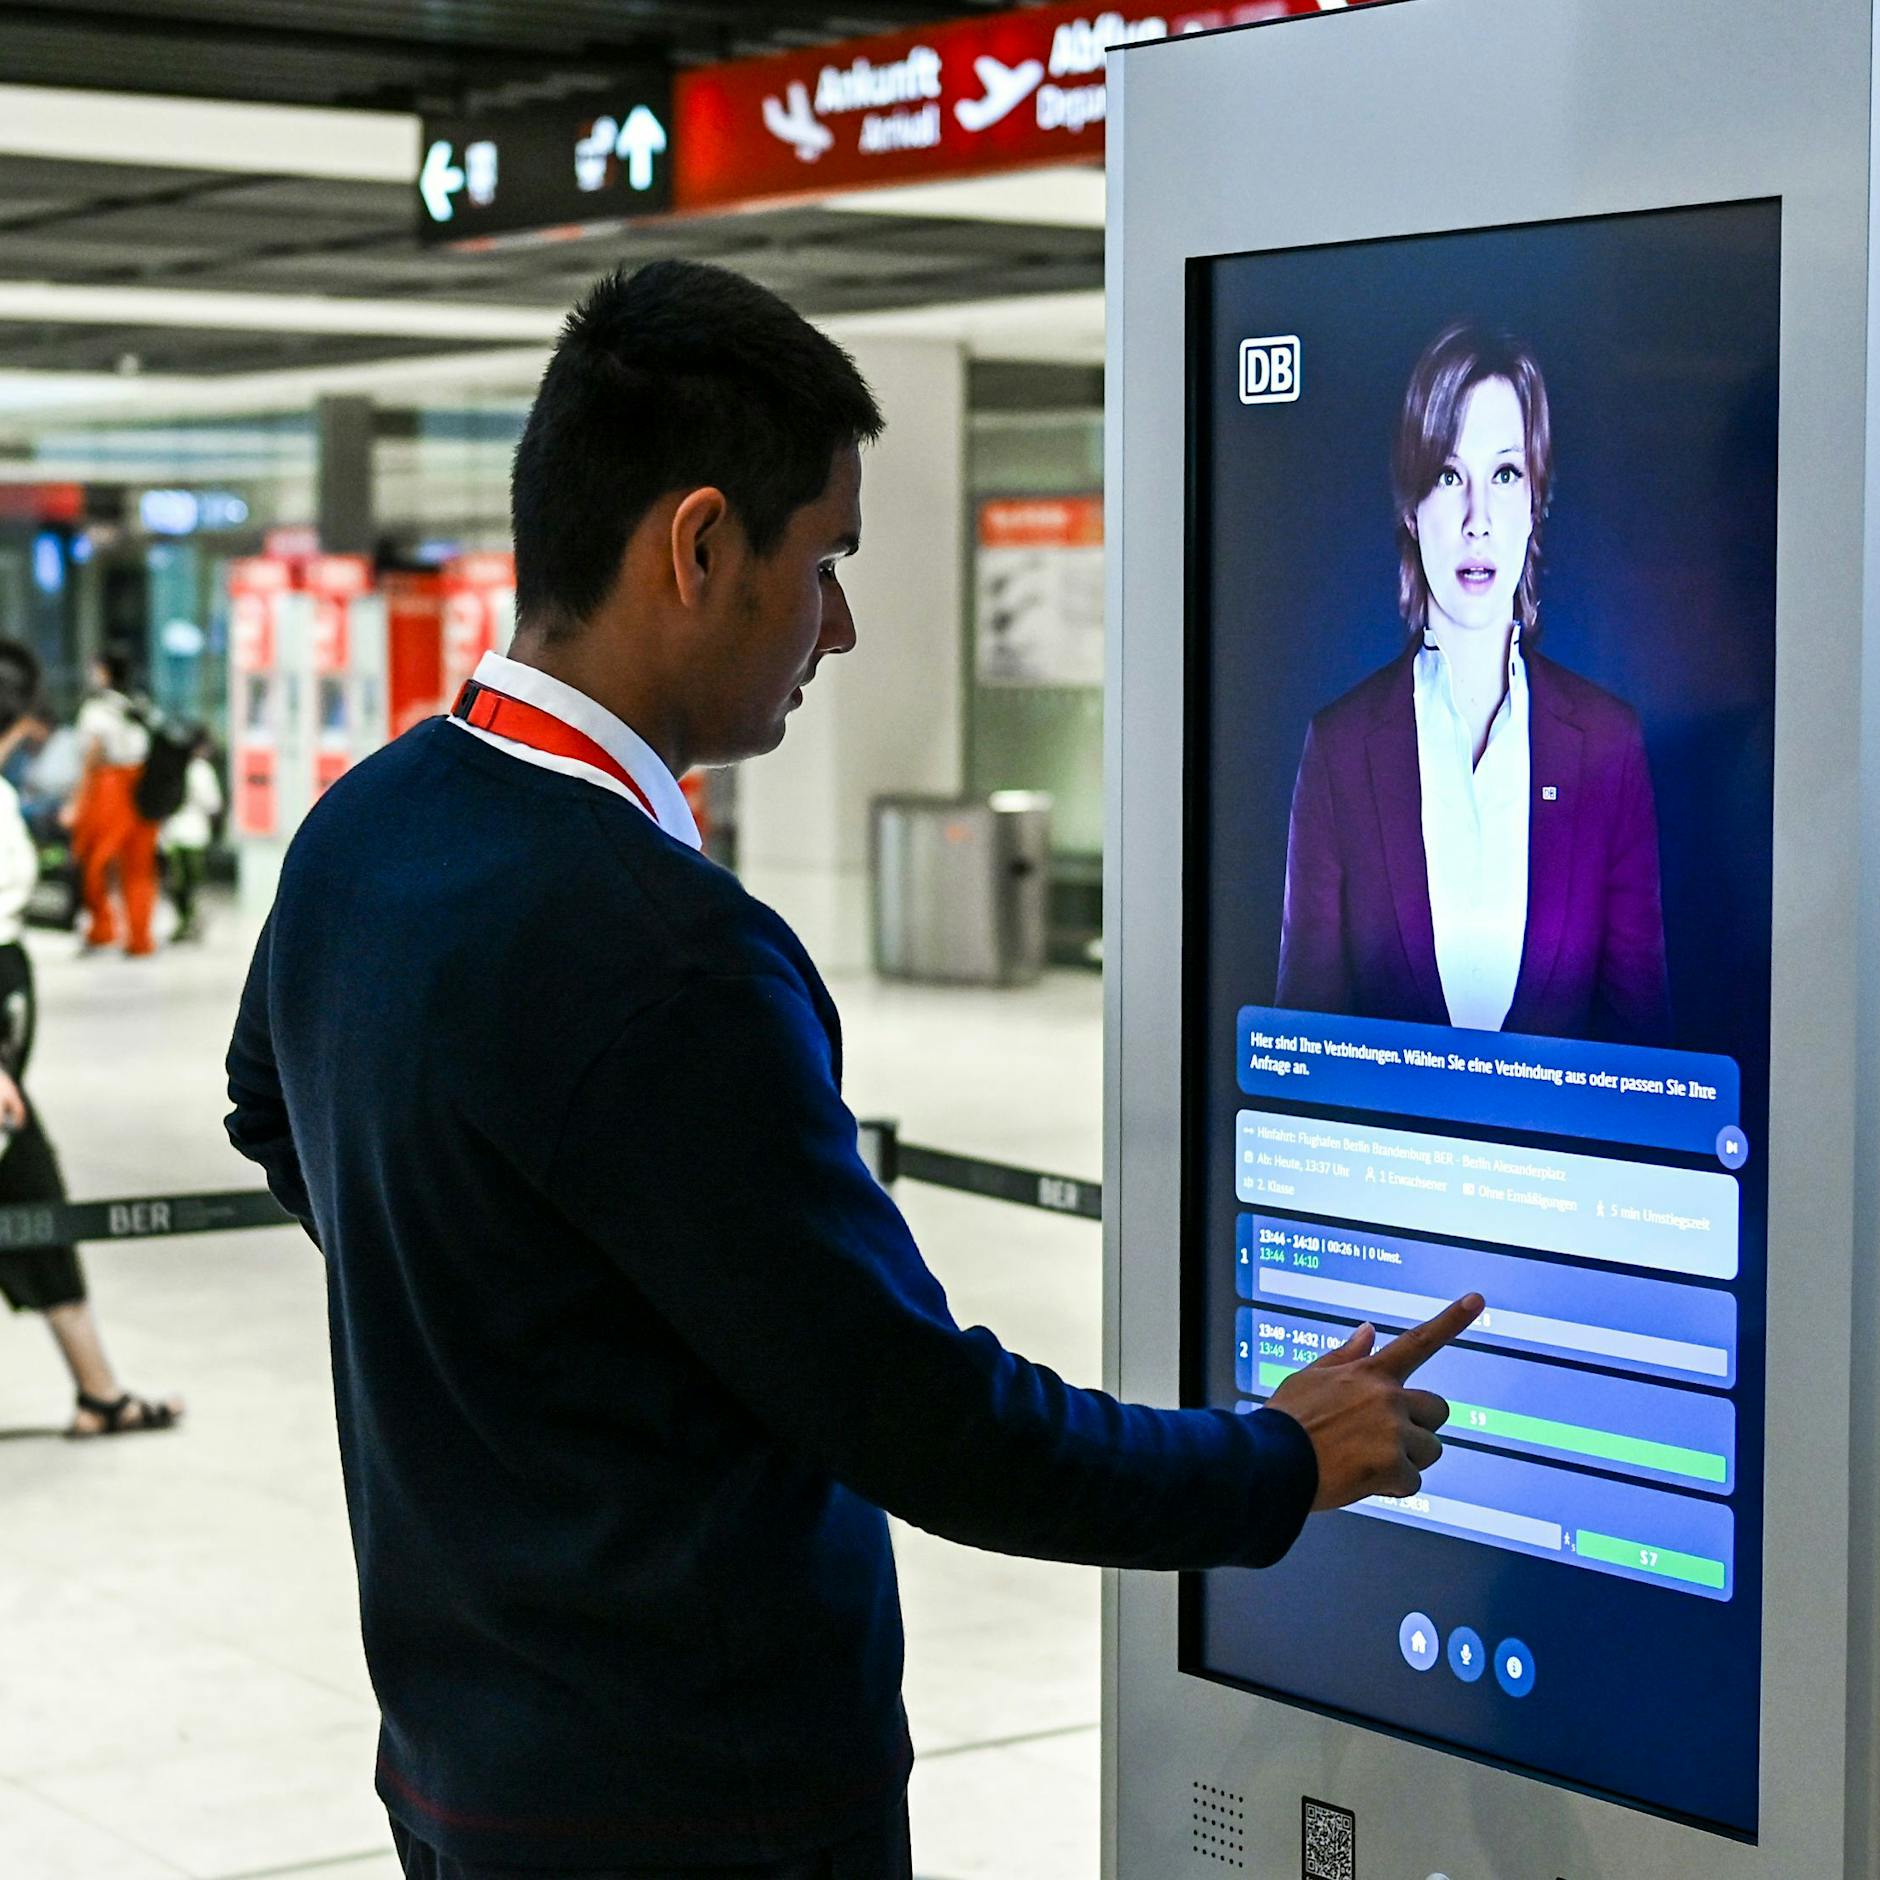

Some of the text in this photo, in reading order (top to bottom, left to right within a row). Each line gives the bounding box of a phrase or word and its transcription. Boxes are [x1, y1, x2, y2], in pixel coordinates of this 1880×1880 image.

[815, 46, 942, 115] Ankunft
[1246, 345, 1294, 395] DB
[1250, 1053, 1310, 1076] Anfrage an.
[1251, 1031, 1717, 1101] Hier sind Ihre Verbindungen. Wählen Sie eine Verbindung aus oder passen Sie Ihre
[1256, 1152, 1351, 1178] Ab: Heute, 13:37 Uhr
[1257, 1126, 1296, 1144] Hinfahrt:
[1298, 1131, 1342, 1150] Flughafen
[1343, 1137, 1370, 1154] Berlin
[1371, 1142, 1431, 1165] Brandenburg
[1433, 1150, 1455, 1166] BER
[1462, 1154, 1491, 1171] Berlin
[1493, 1159, 1568, 1182] Alexanderplatz
[1257, 1178, 1296, 1196] 2. Klasse
[1379, 1170, 1386, 1183] 1
[1478, 1184, 1505, 1201] Ohne
[108, 1202, 171, 1234] BER
[1611, 1203, 1618, 1217] 5
[1620, 1206, 1641, 1222] min
[1240, 1247, 1249, 1265] 1
[1259, 1228, 1287, 1247] 13:44
[1292, 1234, 1320, 1252] 14:10
[1327, 1239, 1353, 1257] 00:26
[1353, 1243, 1361, 1259] h
[1376, 1247, 1402, 1265] Umst.
[1259, 1246, 1319, 1270] 13:44 14:10
[1259, 1323, 1286, 1341] 13:49
[1292, 1328, 1319, 1348] 14:32
[1239, 1341, 1249, 1359] 2
[1259, 1341, 1286, 1359] 13:49
